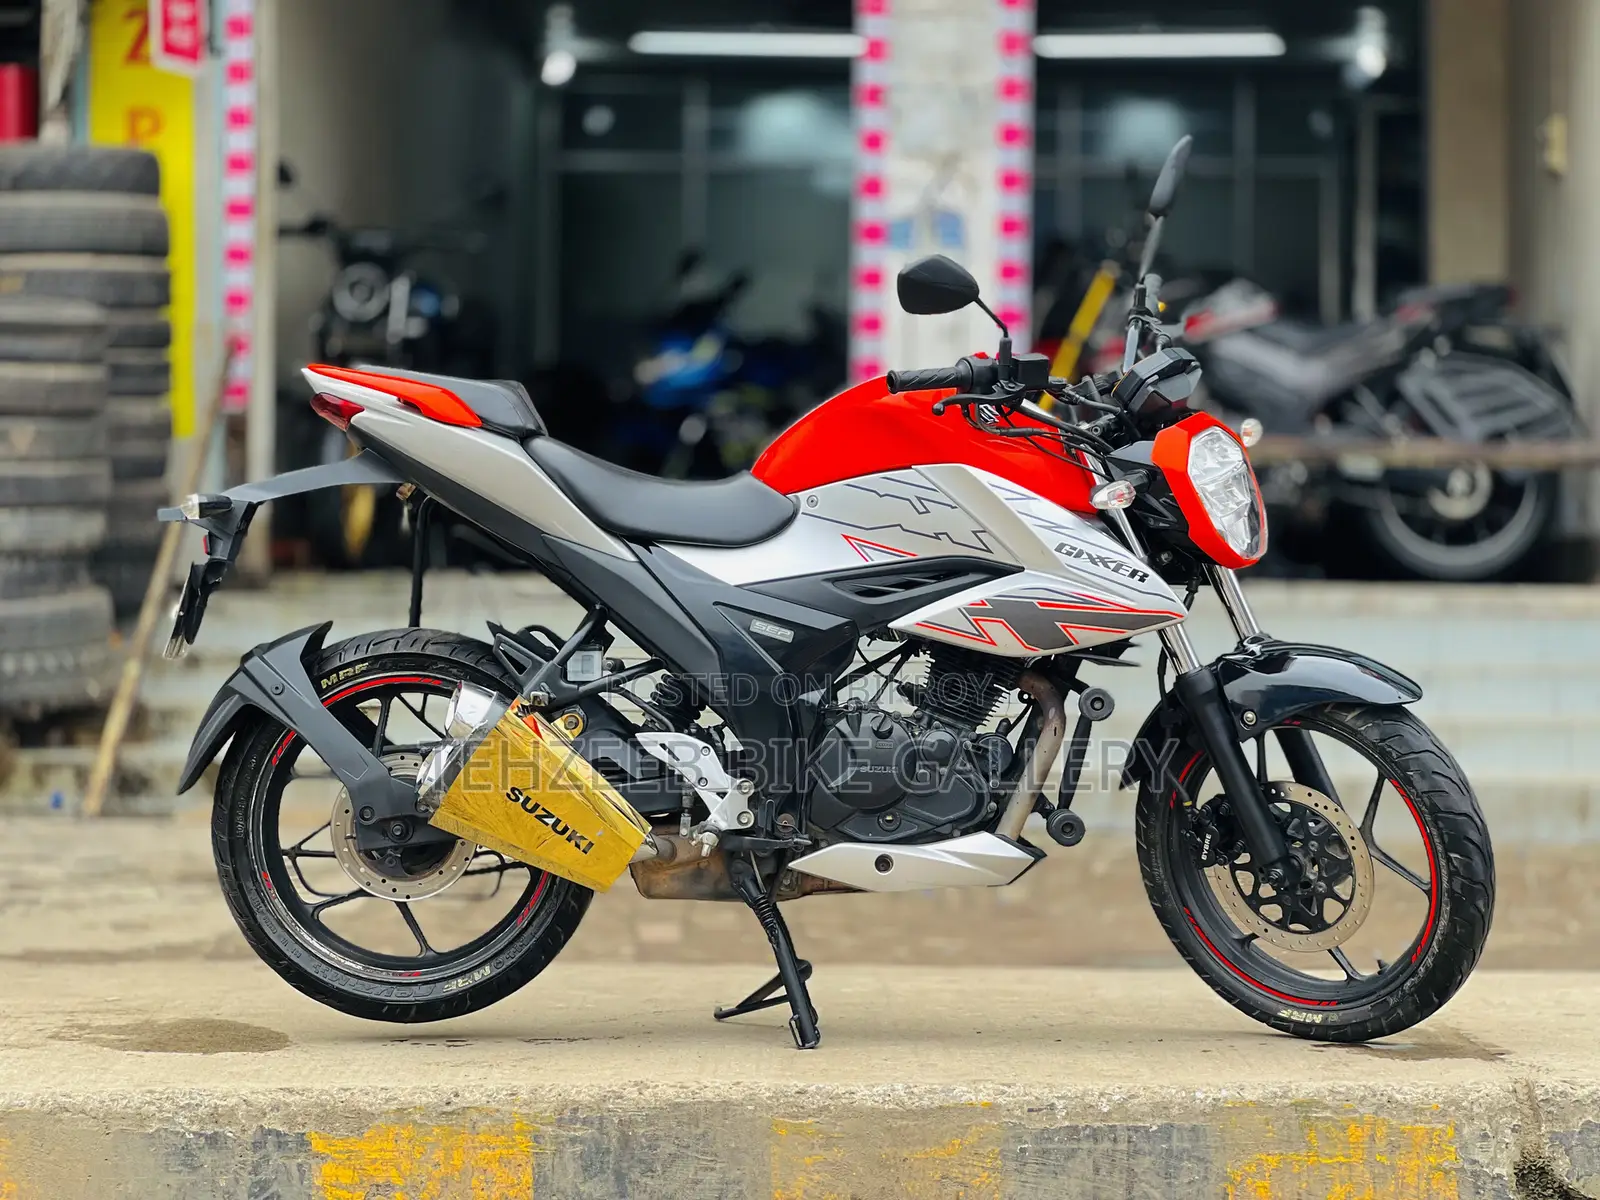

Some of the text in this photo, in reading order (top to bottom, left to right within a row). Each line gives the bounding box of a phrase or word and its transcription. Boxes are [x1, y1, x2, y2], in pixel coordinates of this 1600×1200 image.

[1054, 541, 1150, 583] GIXXER
[320, 662, 369, 689] MRF
[505, 785, 596, 856] SUZUKI
[442, 965, 492, 993] MRF
[1277, 1008, 1323, 1024] MRF
